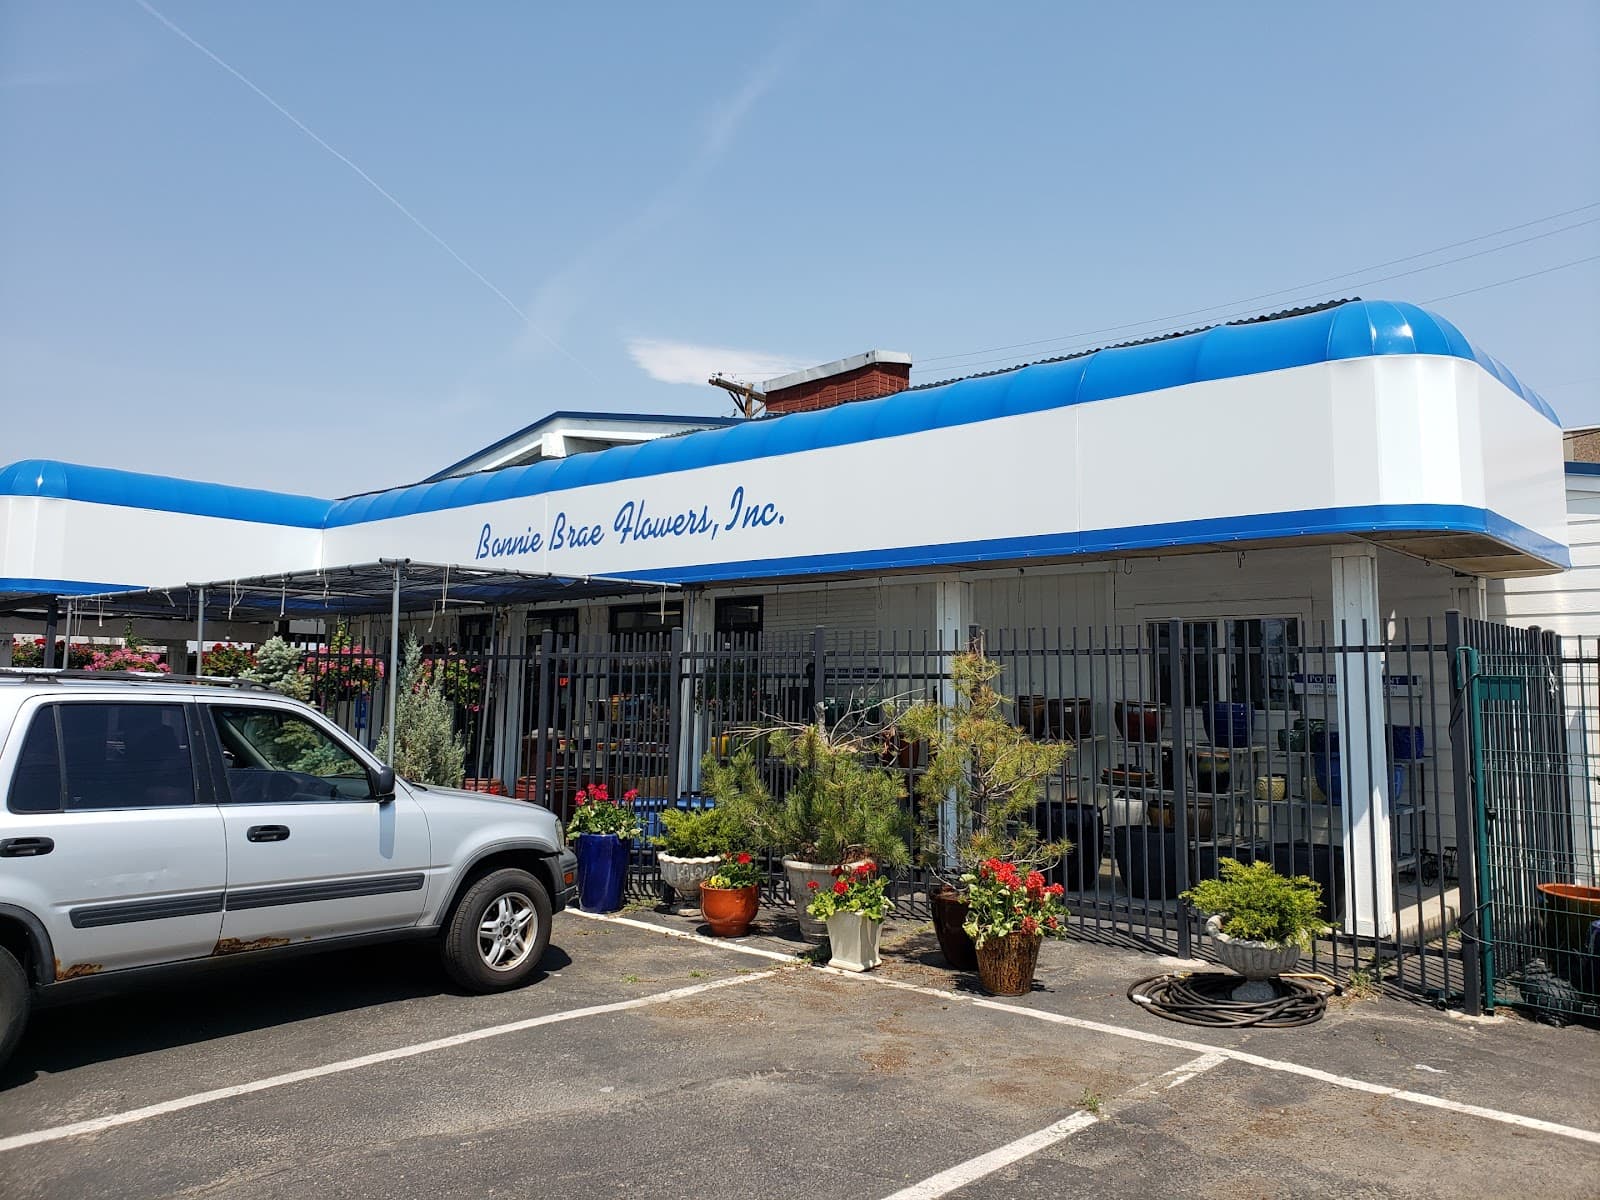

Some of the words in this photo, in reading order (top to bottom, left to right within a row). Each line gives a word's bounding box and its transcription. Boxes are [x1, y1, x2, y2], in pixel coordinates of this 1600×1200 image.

[475, 523, 544, 560] Bonnie
[549, 512, 605, 551] Brae
[613, 499, 720, 544] Flowers,
[725, 485, 785, 531] Inc.
